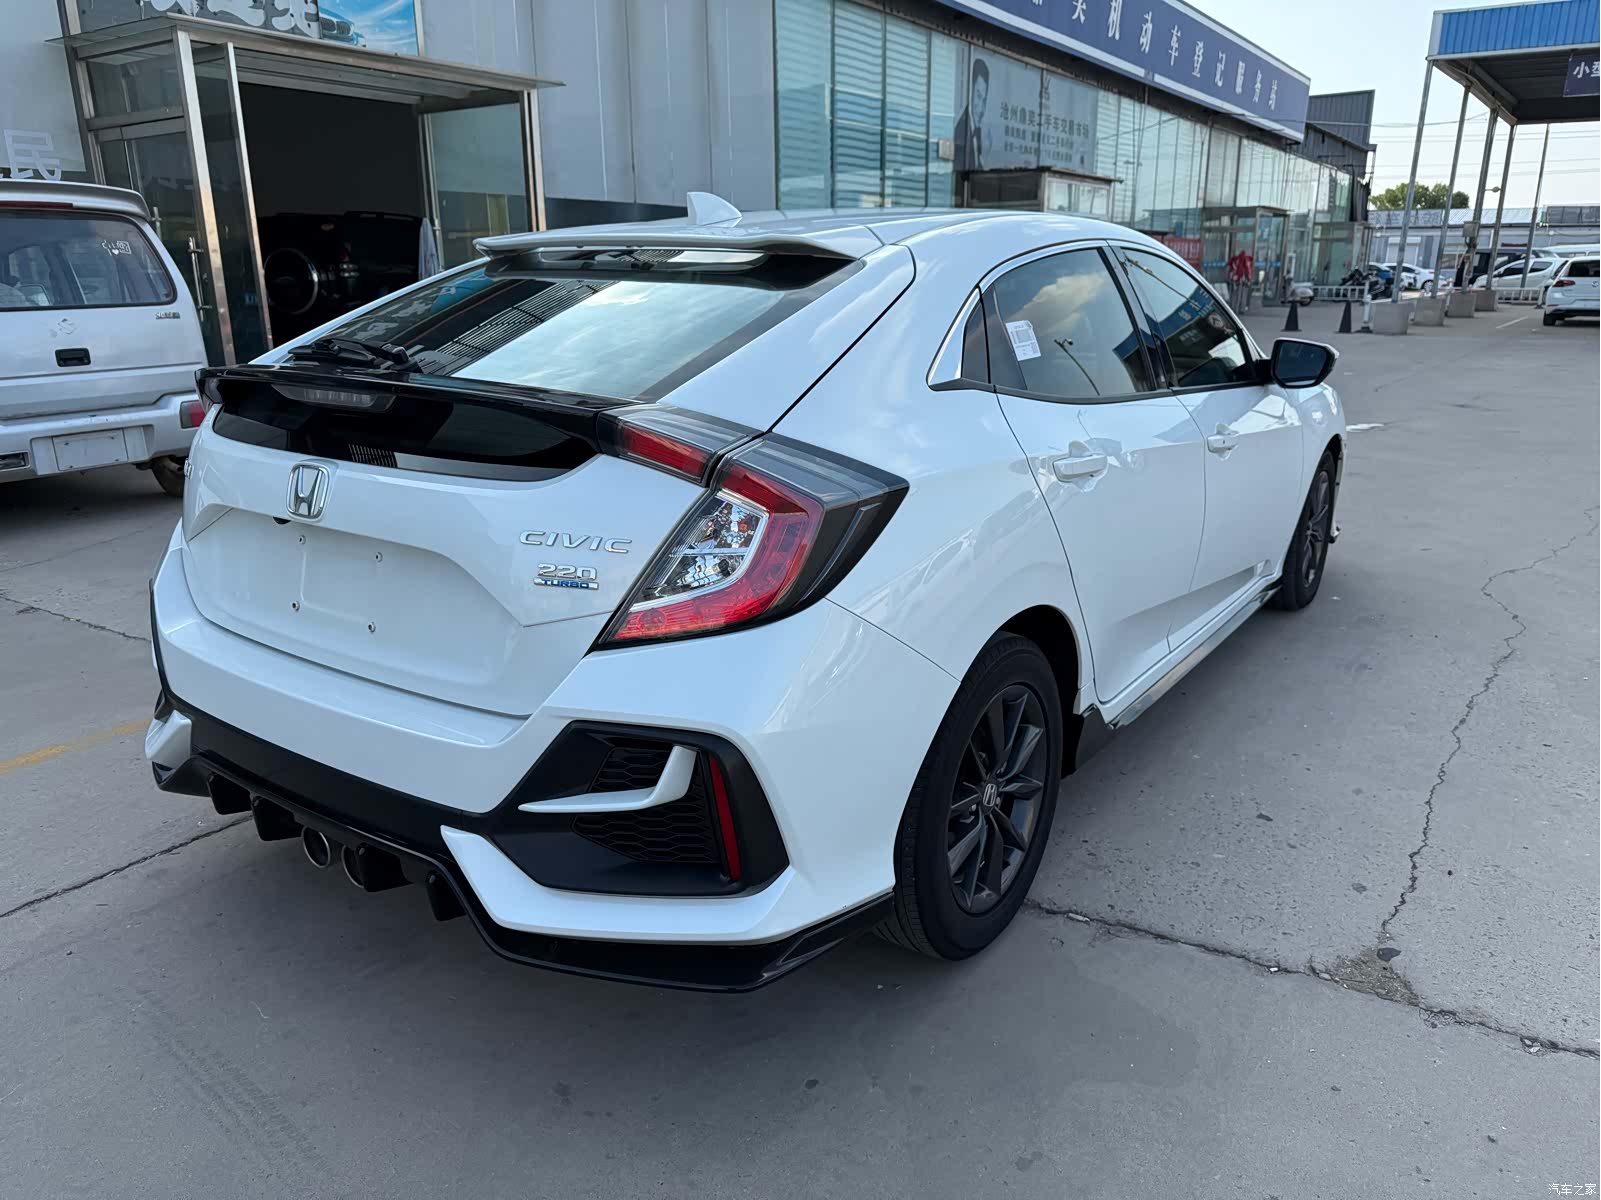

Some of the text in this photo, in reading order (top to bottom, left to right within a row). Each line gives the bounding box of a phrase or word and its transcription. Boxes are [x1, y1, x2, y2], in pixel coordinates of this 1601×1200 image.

[1033, 0, 1278, 111] 机动车登记服务站
[519, 530, 633, 554] CIVIC
[537, 563, 598, 581] 220
[541, 578, 592, 589] TURBO
